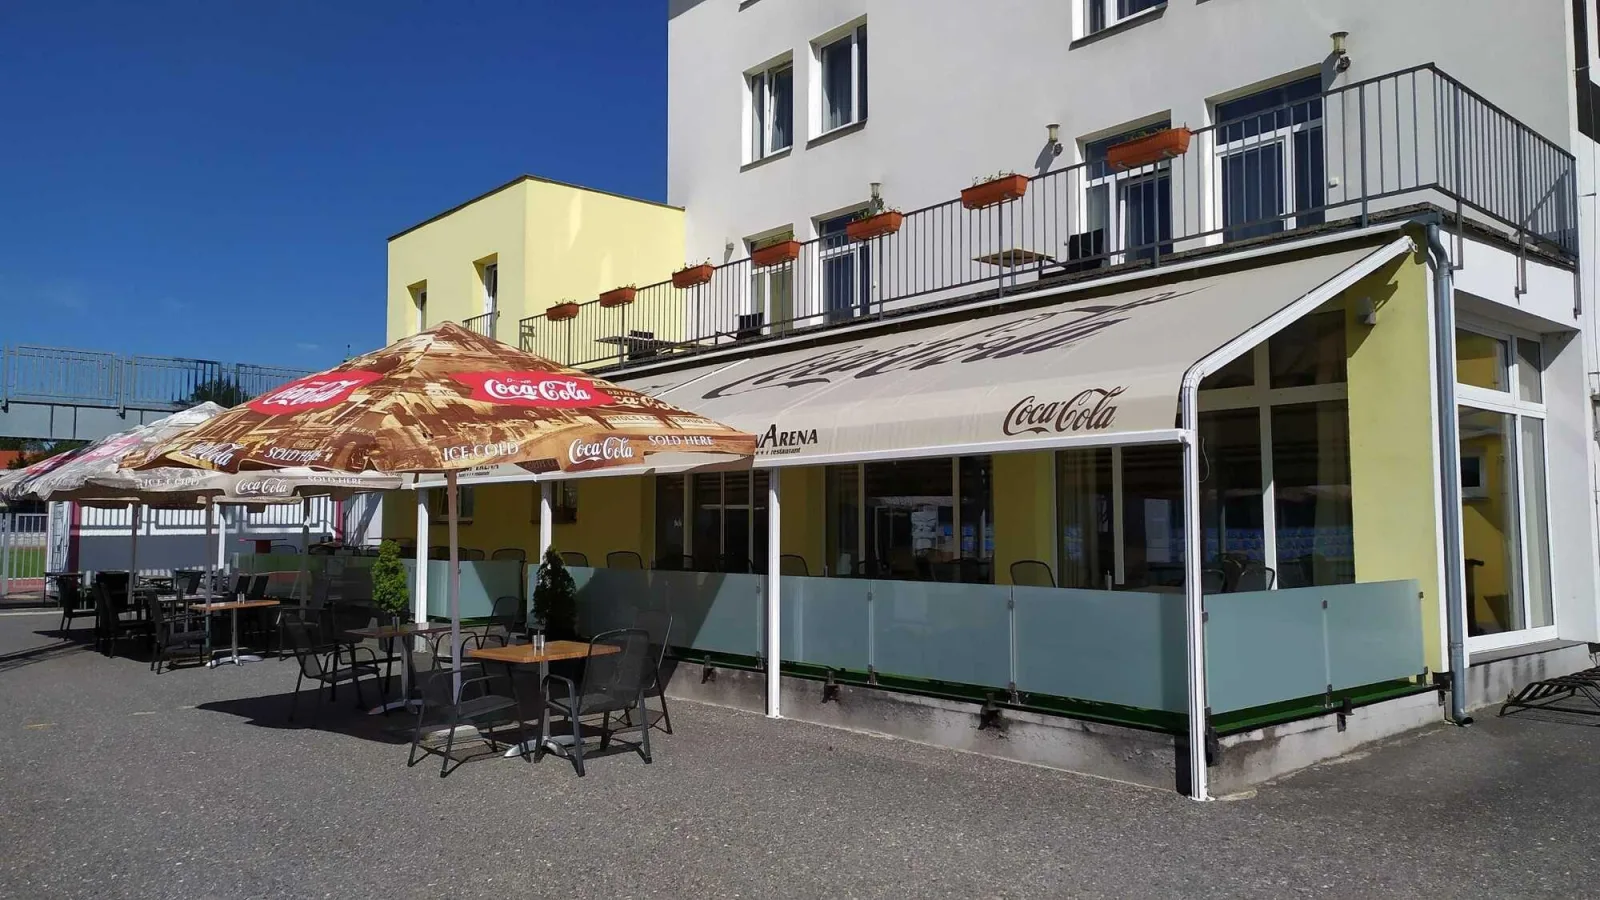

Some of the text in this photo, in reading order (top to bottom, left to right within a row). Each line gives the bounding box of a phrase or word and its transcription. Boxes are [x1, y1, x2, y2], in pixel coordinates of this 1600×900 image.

[484, 378, 591, 401] Coca-Cola
[1003, 385, 1129, 436] Coca-Cola
[648, 434, 714, 447] SOLD HERE
[263, 446, 299, 462] SOLD
[443, 442, 519, 461] ICE COLD
[568, 436, 633, 465] Coca-Cola
[770, 447, 801, 456] restaurant
[235, 477, 288, 495] Coca-Cola
